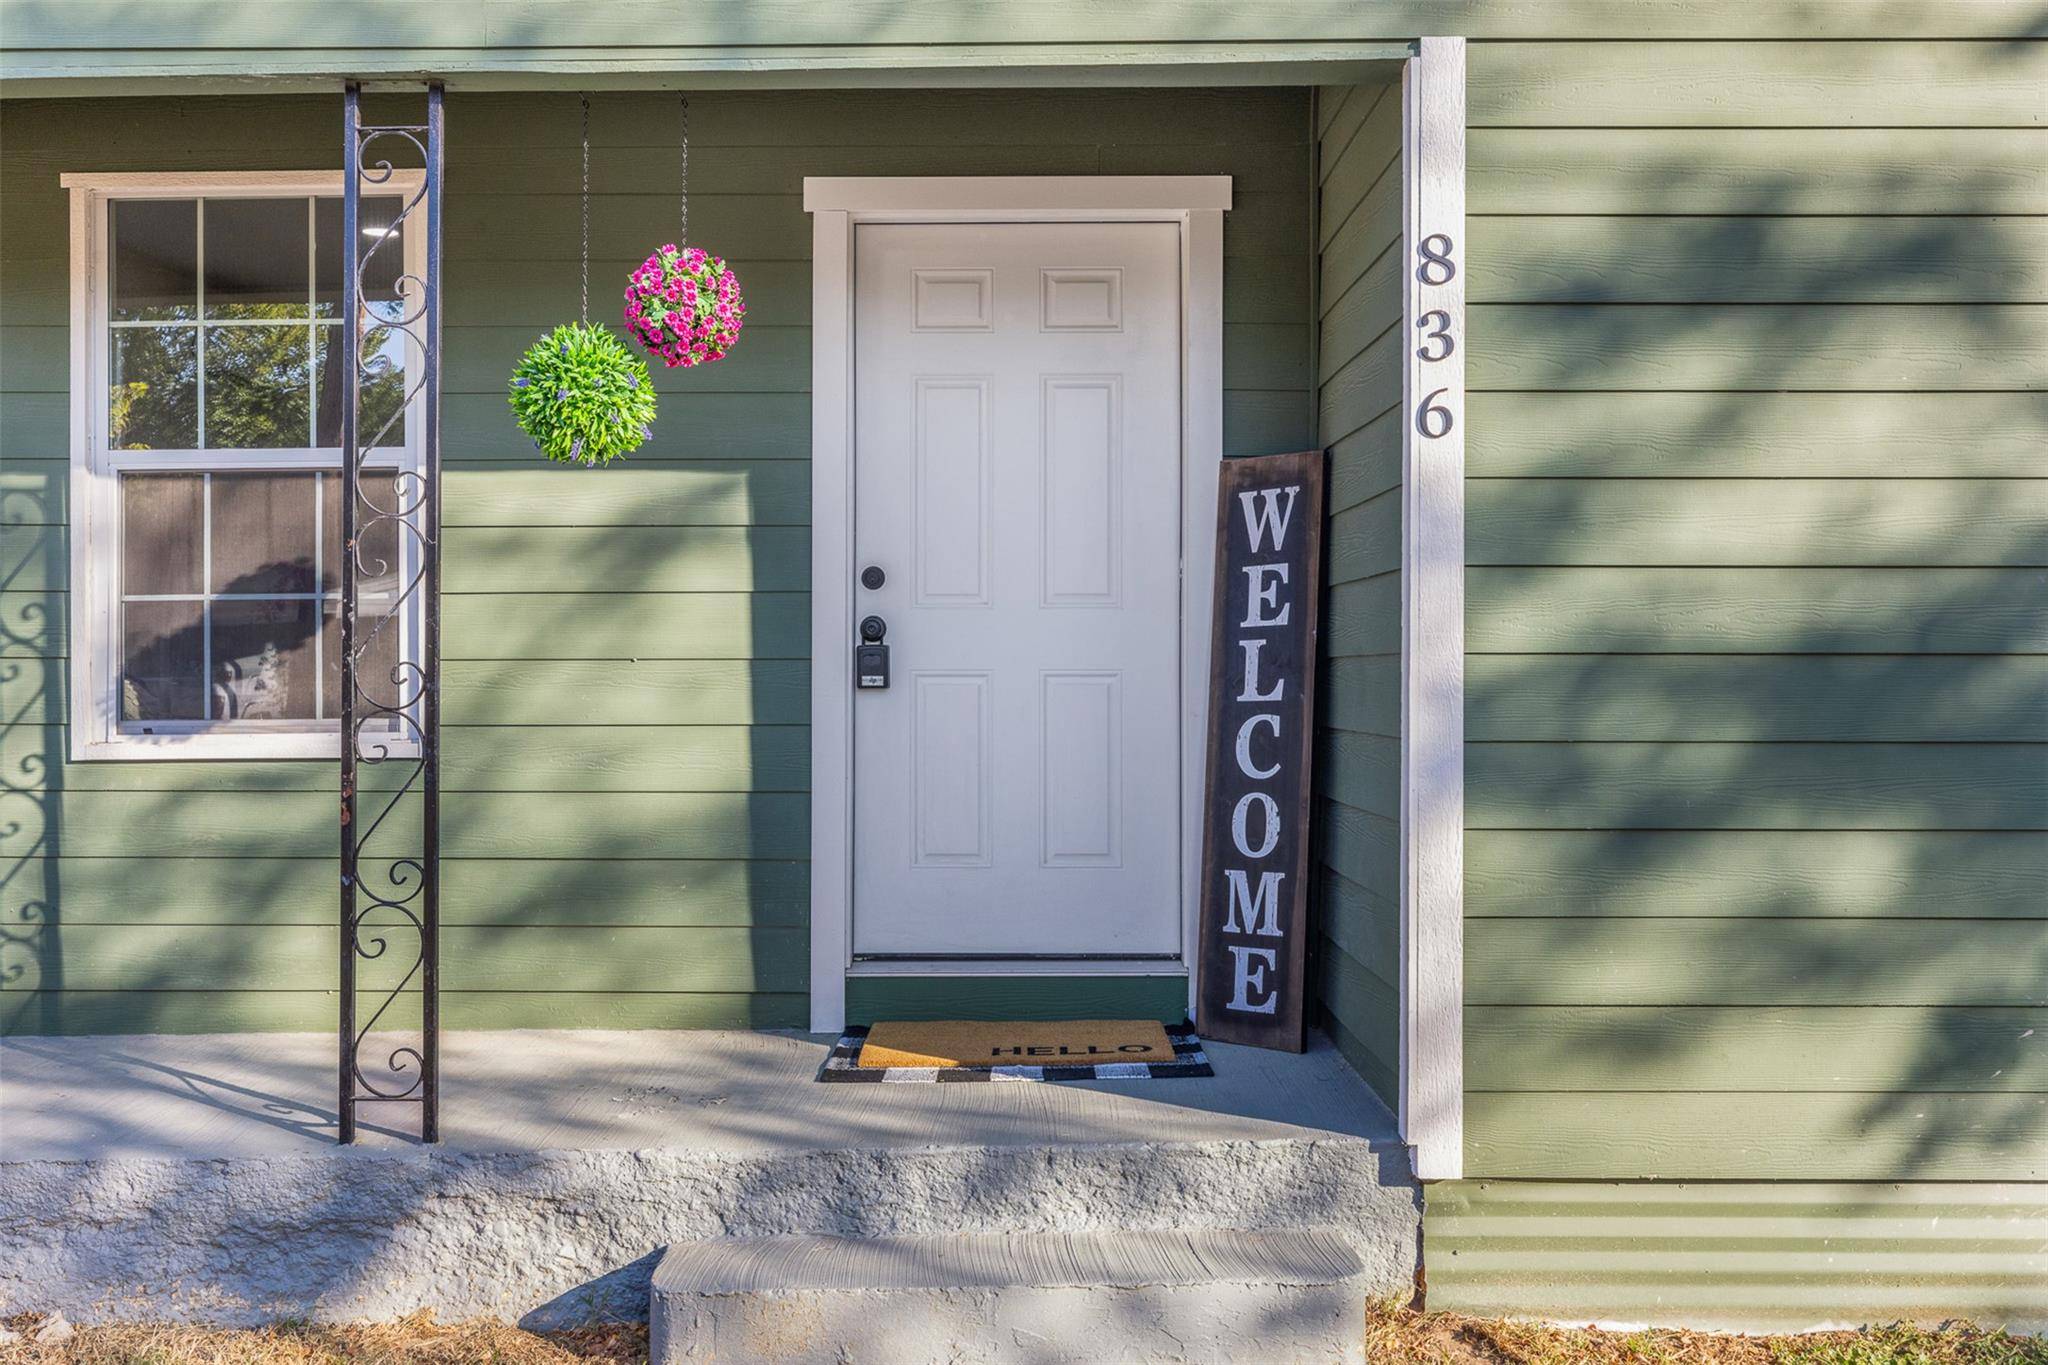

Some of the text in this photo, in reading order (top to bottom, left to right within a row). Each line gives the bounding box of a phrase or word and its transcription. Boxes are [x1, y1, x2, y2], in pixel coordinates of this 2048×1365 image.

[1415, 233, 1456, 439] 836
[1222, 485, 1300, 1014] WELCOME
[992, 1044, 1153, 1056] HELLO
